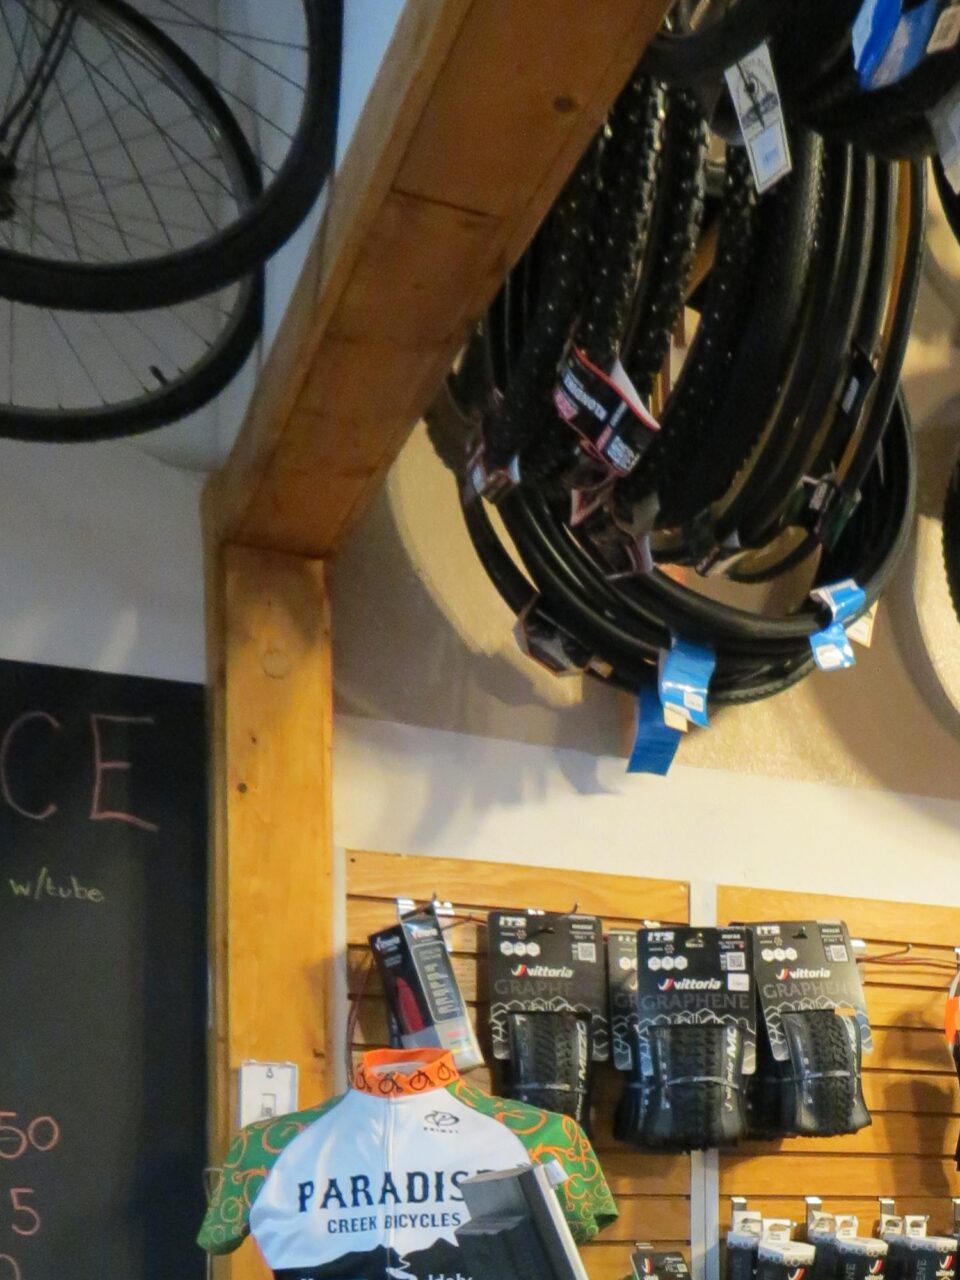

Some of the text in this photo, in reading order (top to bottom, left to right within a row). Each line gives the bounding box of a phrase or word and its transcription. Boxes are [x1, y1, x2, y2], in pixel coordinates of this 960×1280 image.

[9, 867, 104, 902] w/tube
[525, 965, 574, 978] vittoria
[789, 968, 831, 980] vittoria
[673, 978, 721, 991] vittoria
[297, 1168, 495, 1214] PARADIS
[327, 1212, 462, 1235] CREEK BICYCLES
